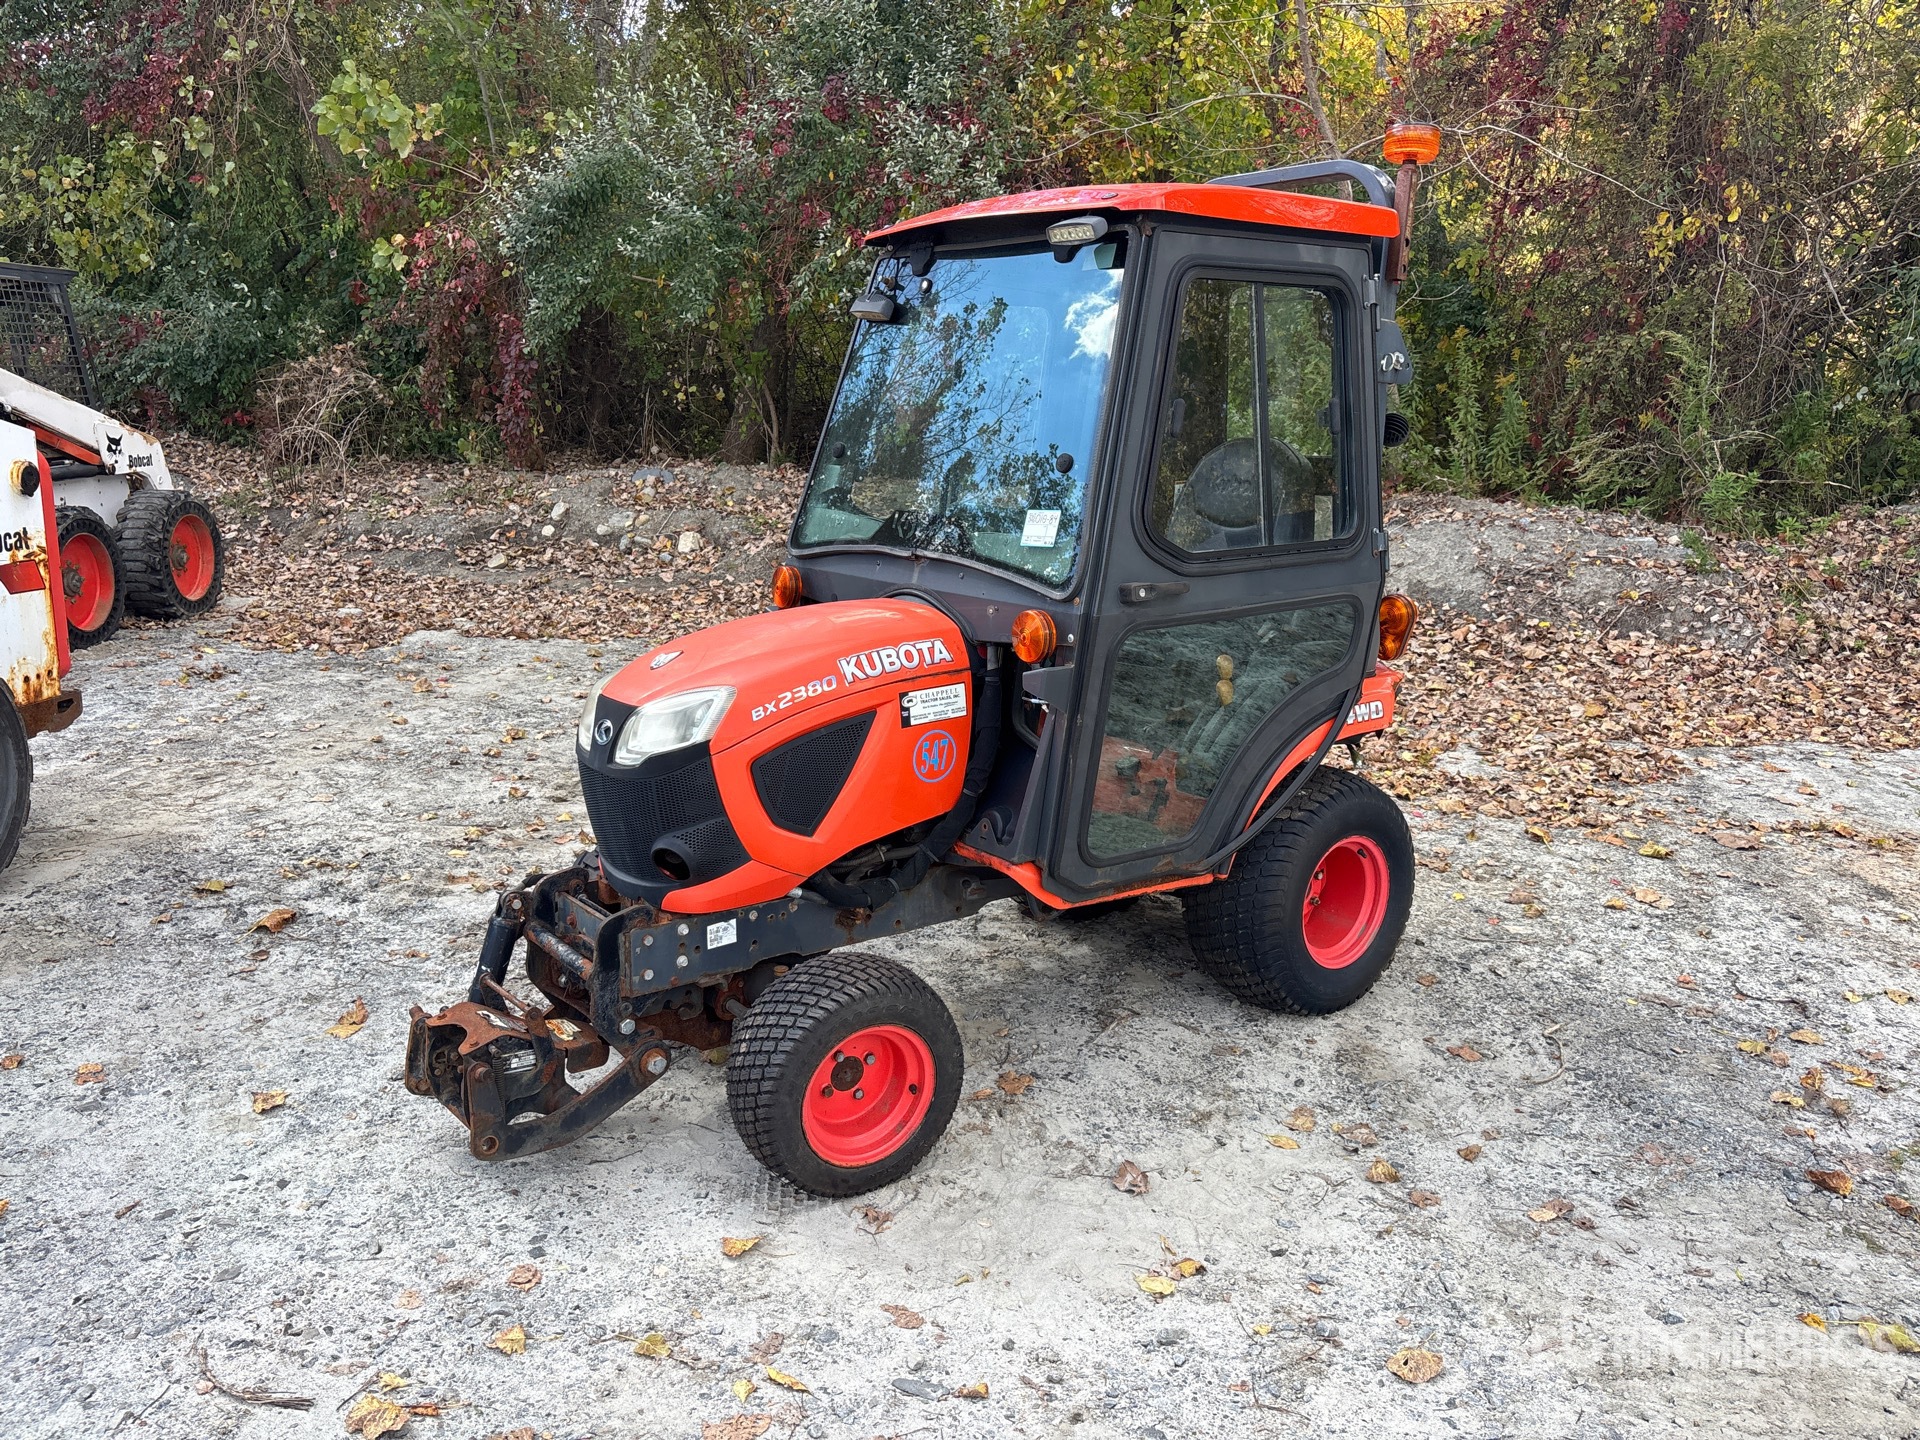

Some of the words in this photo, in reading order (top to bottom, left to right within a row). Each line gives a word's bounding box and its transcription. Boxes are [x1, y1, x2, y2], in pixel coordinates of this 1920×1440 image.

[128, 453, 153, 469] Bobcat
[0, 527, 30, 553] cat
[838, 638, 954, 685] KUBOTA
[751, 675, 837, 721] BX2380
[920, 687, 959, 699] CHAPPELL
[920, 738, 949, 774] 547
